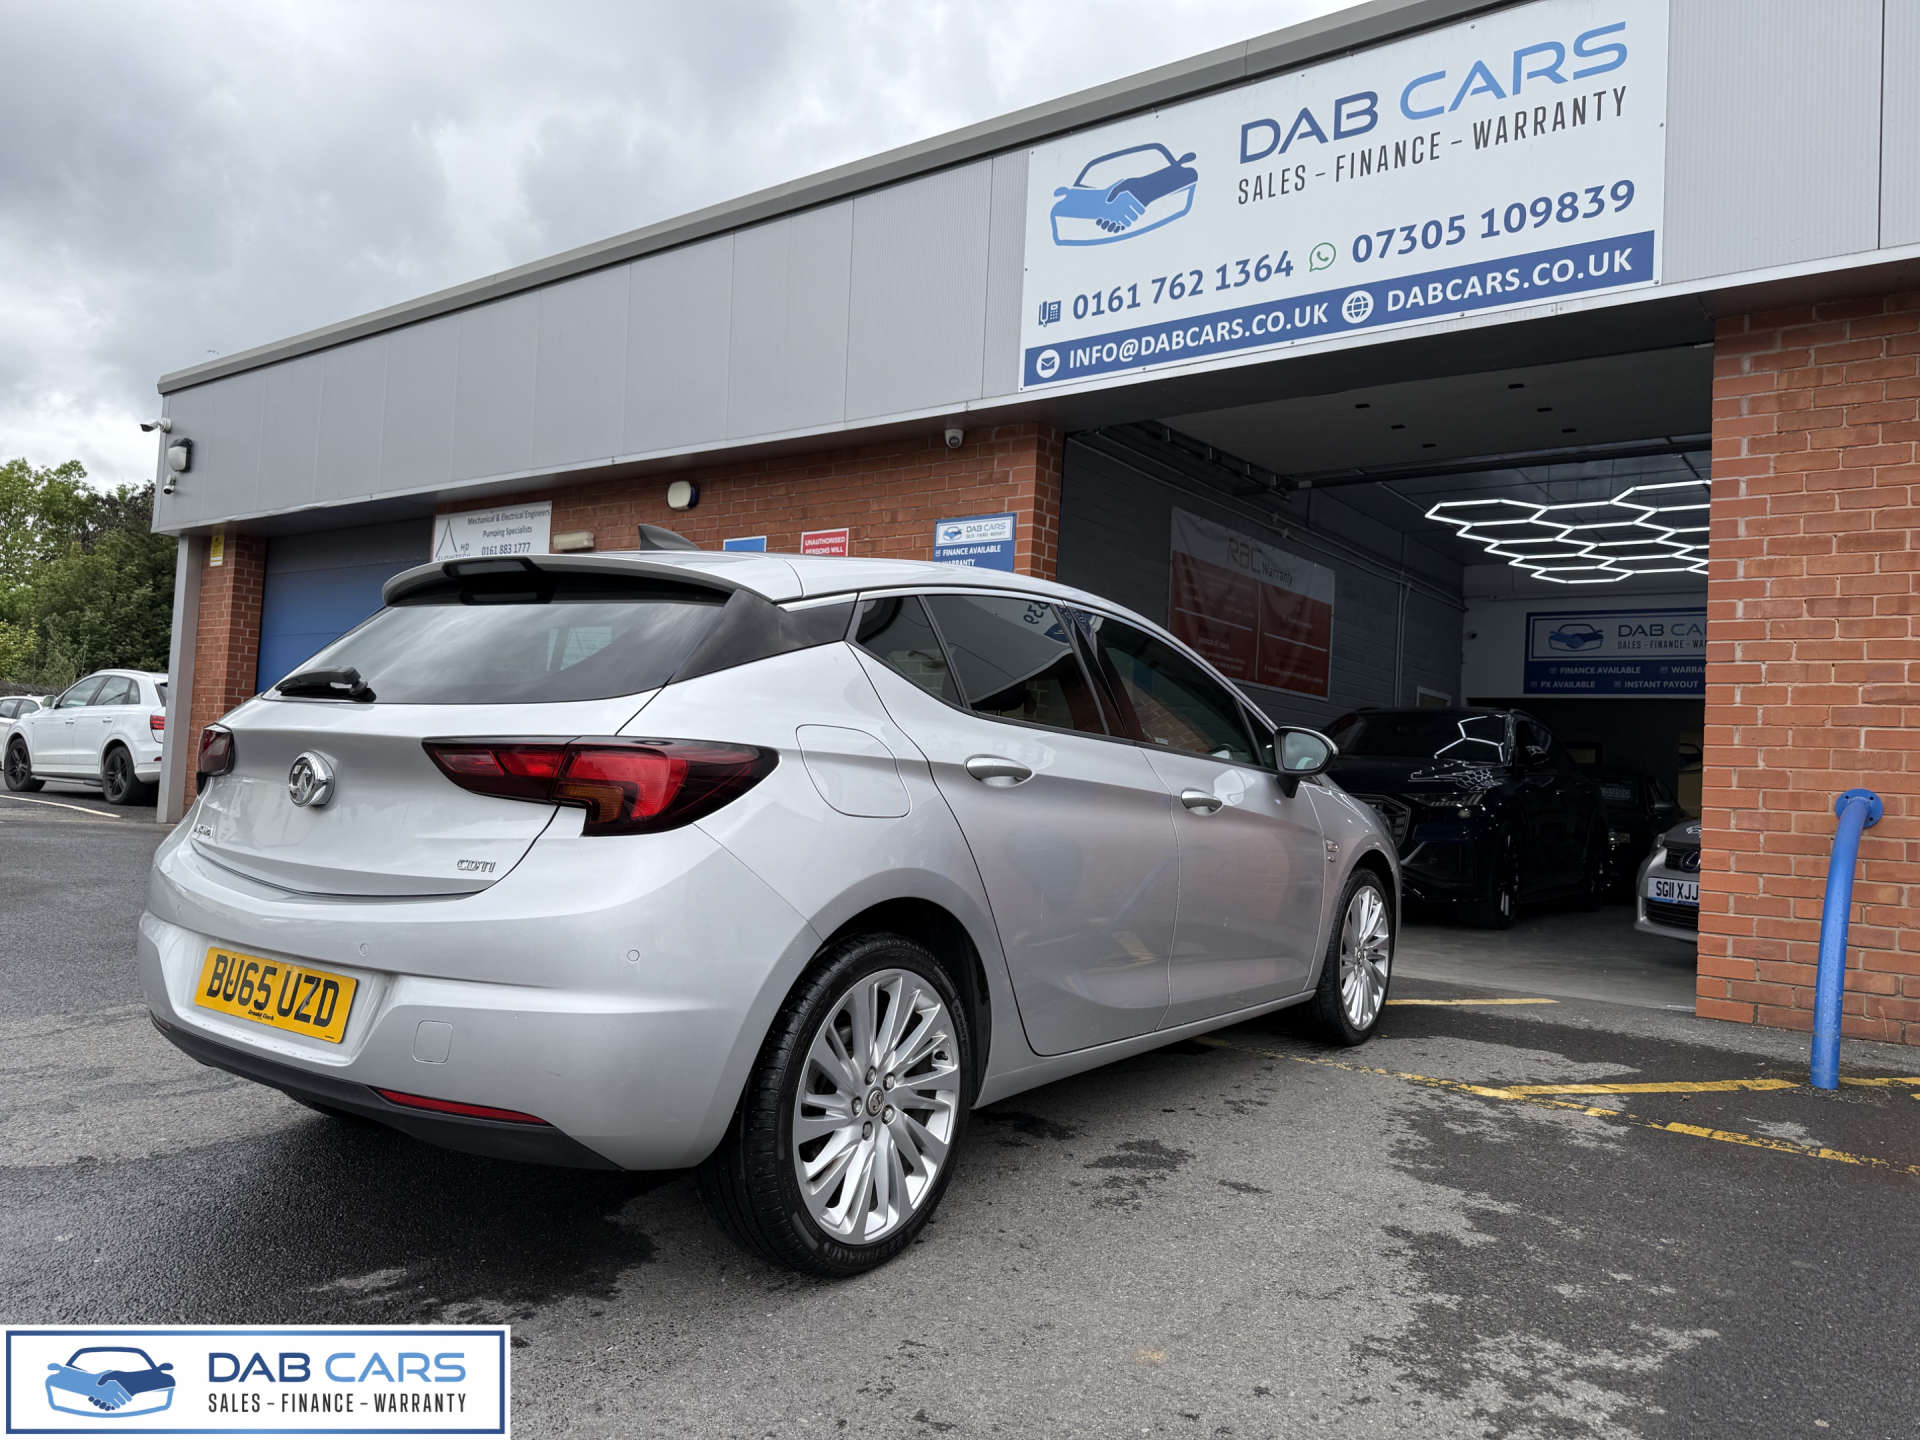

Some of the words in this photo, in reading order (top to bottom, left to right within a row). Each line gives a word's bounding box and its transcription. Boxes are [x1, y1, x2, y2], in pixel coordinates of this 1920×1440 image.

[1240, 91, 1379, 164] DAB
[1400, 21, 1628, 121] CARS
[1238, 164, 1306, 205] SALES
[1335, 131, 1441, 182] FINANCE
[1473, 86, 1627, 150] WARRANTY
[1352, 214, 1466, 263] 07305
[1480, 179, 1635, 239] 109839
[1073, 283, 1141, 320] 0161
[1151, 269, 1204, 304] 762
[1215, 250, 1294, 291] 1364
[1387, 247, 1633, 312] DABCARS.CO.UK
[1069, 302, 1329, 369] INFO@DABCARS.CO.UK
[467, 513, 495, 525] Mechanical
[501, 511, 523, 521] Electrical
[482, 529, 505, 538] Pumping
[966, 525, 982, 533] DAB
[983, 521, 1006, 531] CARS
[481, 545, 498, 556] 0161
[499, 543, 512, 554] 883
[513, 542, 531, 554] 1777
[831, 546, 843, 554] WILL
[943, 547, 968, 557] FINANCE
[969, 544, 1001, 554] AVAILABLE
[1617, 624, 1664, 638] DAB
[1670, 623, 1706, 637] CA
[1617, 640, 1641, 649] SALES
[1650, 639, 1684, 649] FINANCE
[1560, 666, 1597, 674] FINANCE
[1598, 666, 1641, 674] AVAILABLE
[1553, 680, 1596, 688] AVAILABLE
[1624, 680, 1662, 688] INSTANT
[1663, 680, 1699, 688] PAYOUT
[206, 954, 278, 1010] BU65
[277, 970, 340, 1028] UZD
